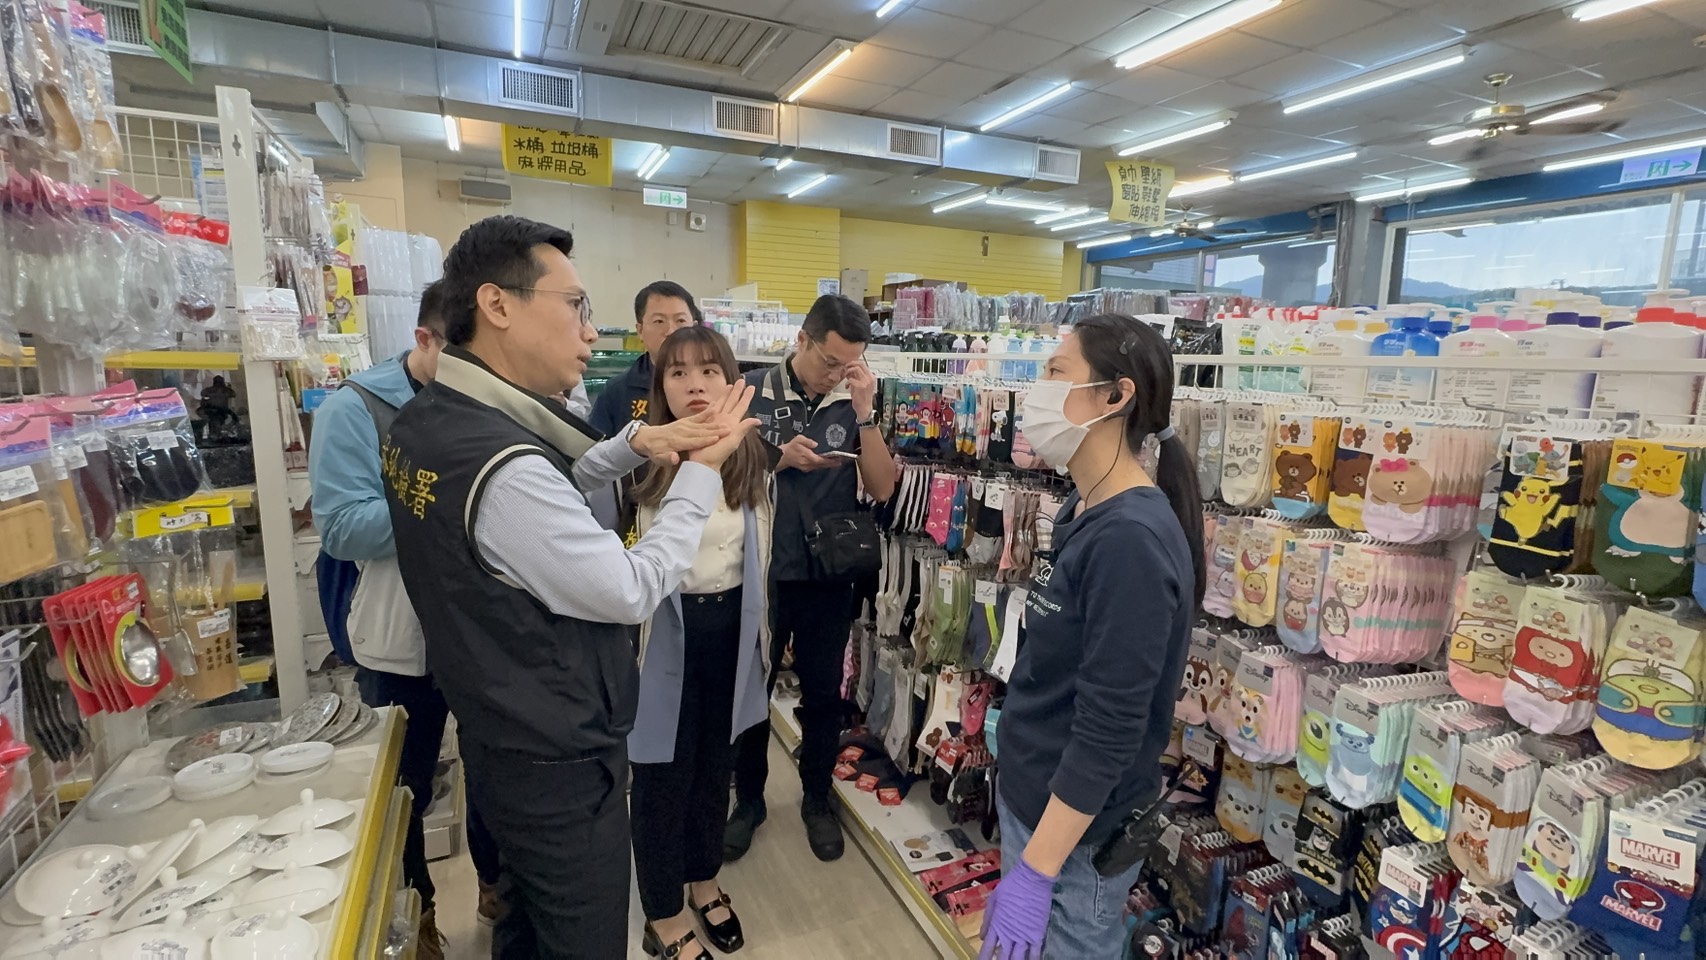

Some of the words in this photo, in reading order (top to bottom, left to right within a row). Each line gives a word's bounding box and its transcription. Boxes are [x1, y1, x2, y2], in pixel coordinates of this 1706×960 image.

[755, 412, 804, 433] 調局
[1228, 443, 1263, 457] HEART
[1242, 663, 1270, 683] Disney
[1343, 697, 1374, 721] Disney
[1417, 722, 1443, 749] Disney
[1466, 758, 1499, 788] Disney
[1546, 783, 1579, 817] Disney
[1301, 847, 1337, 869] BATMAN
[1621, 837, 1679, 868] MARVEL
[1386, 863, 1420, 891] MARVEL
[1604, 897, 1657, 929] MARVEL
